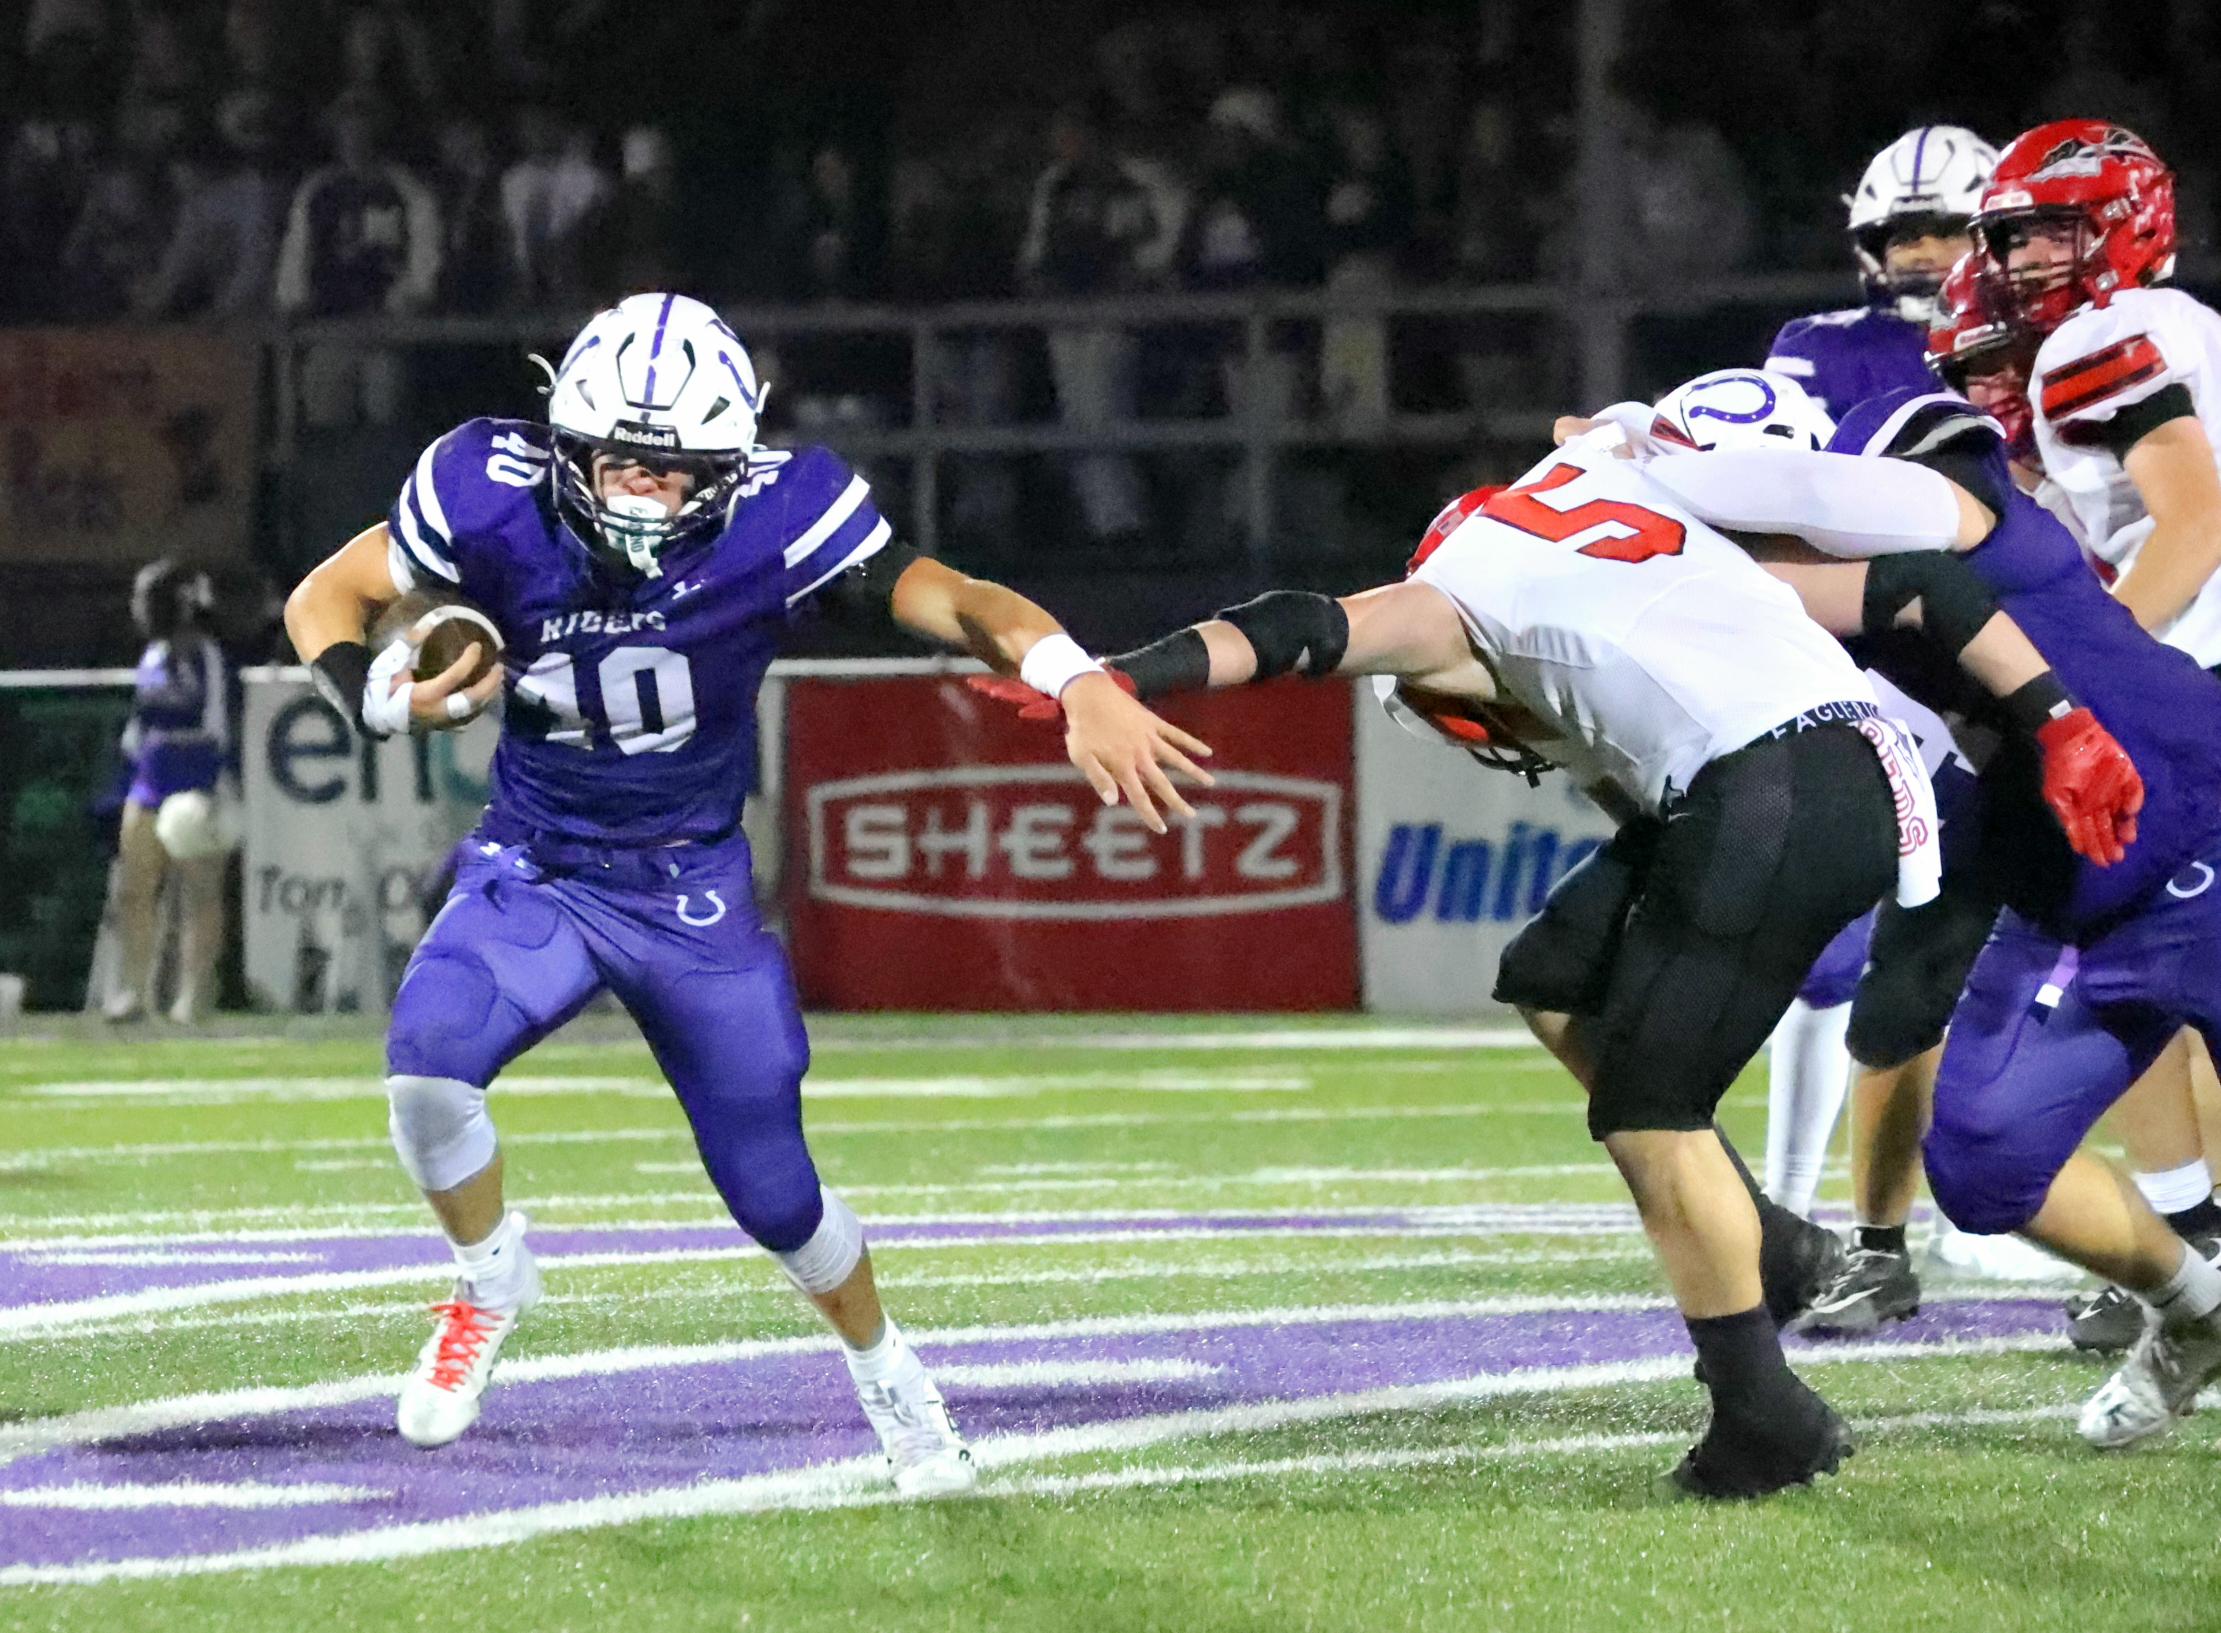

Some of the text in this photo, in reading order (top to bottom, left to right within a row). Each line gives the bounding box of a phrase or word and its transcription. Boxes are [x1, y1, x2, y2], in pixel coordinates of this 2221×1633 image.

[613, 426, 677, 448] Riddell
[1477, 461, 1688, 565] 5
[845, 803, 1300, 880] SHEETZ
